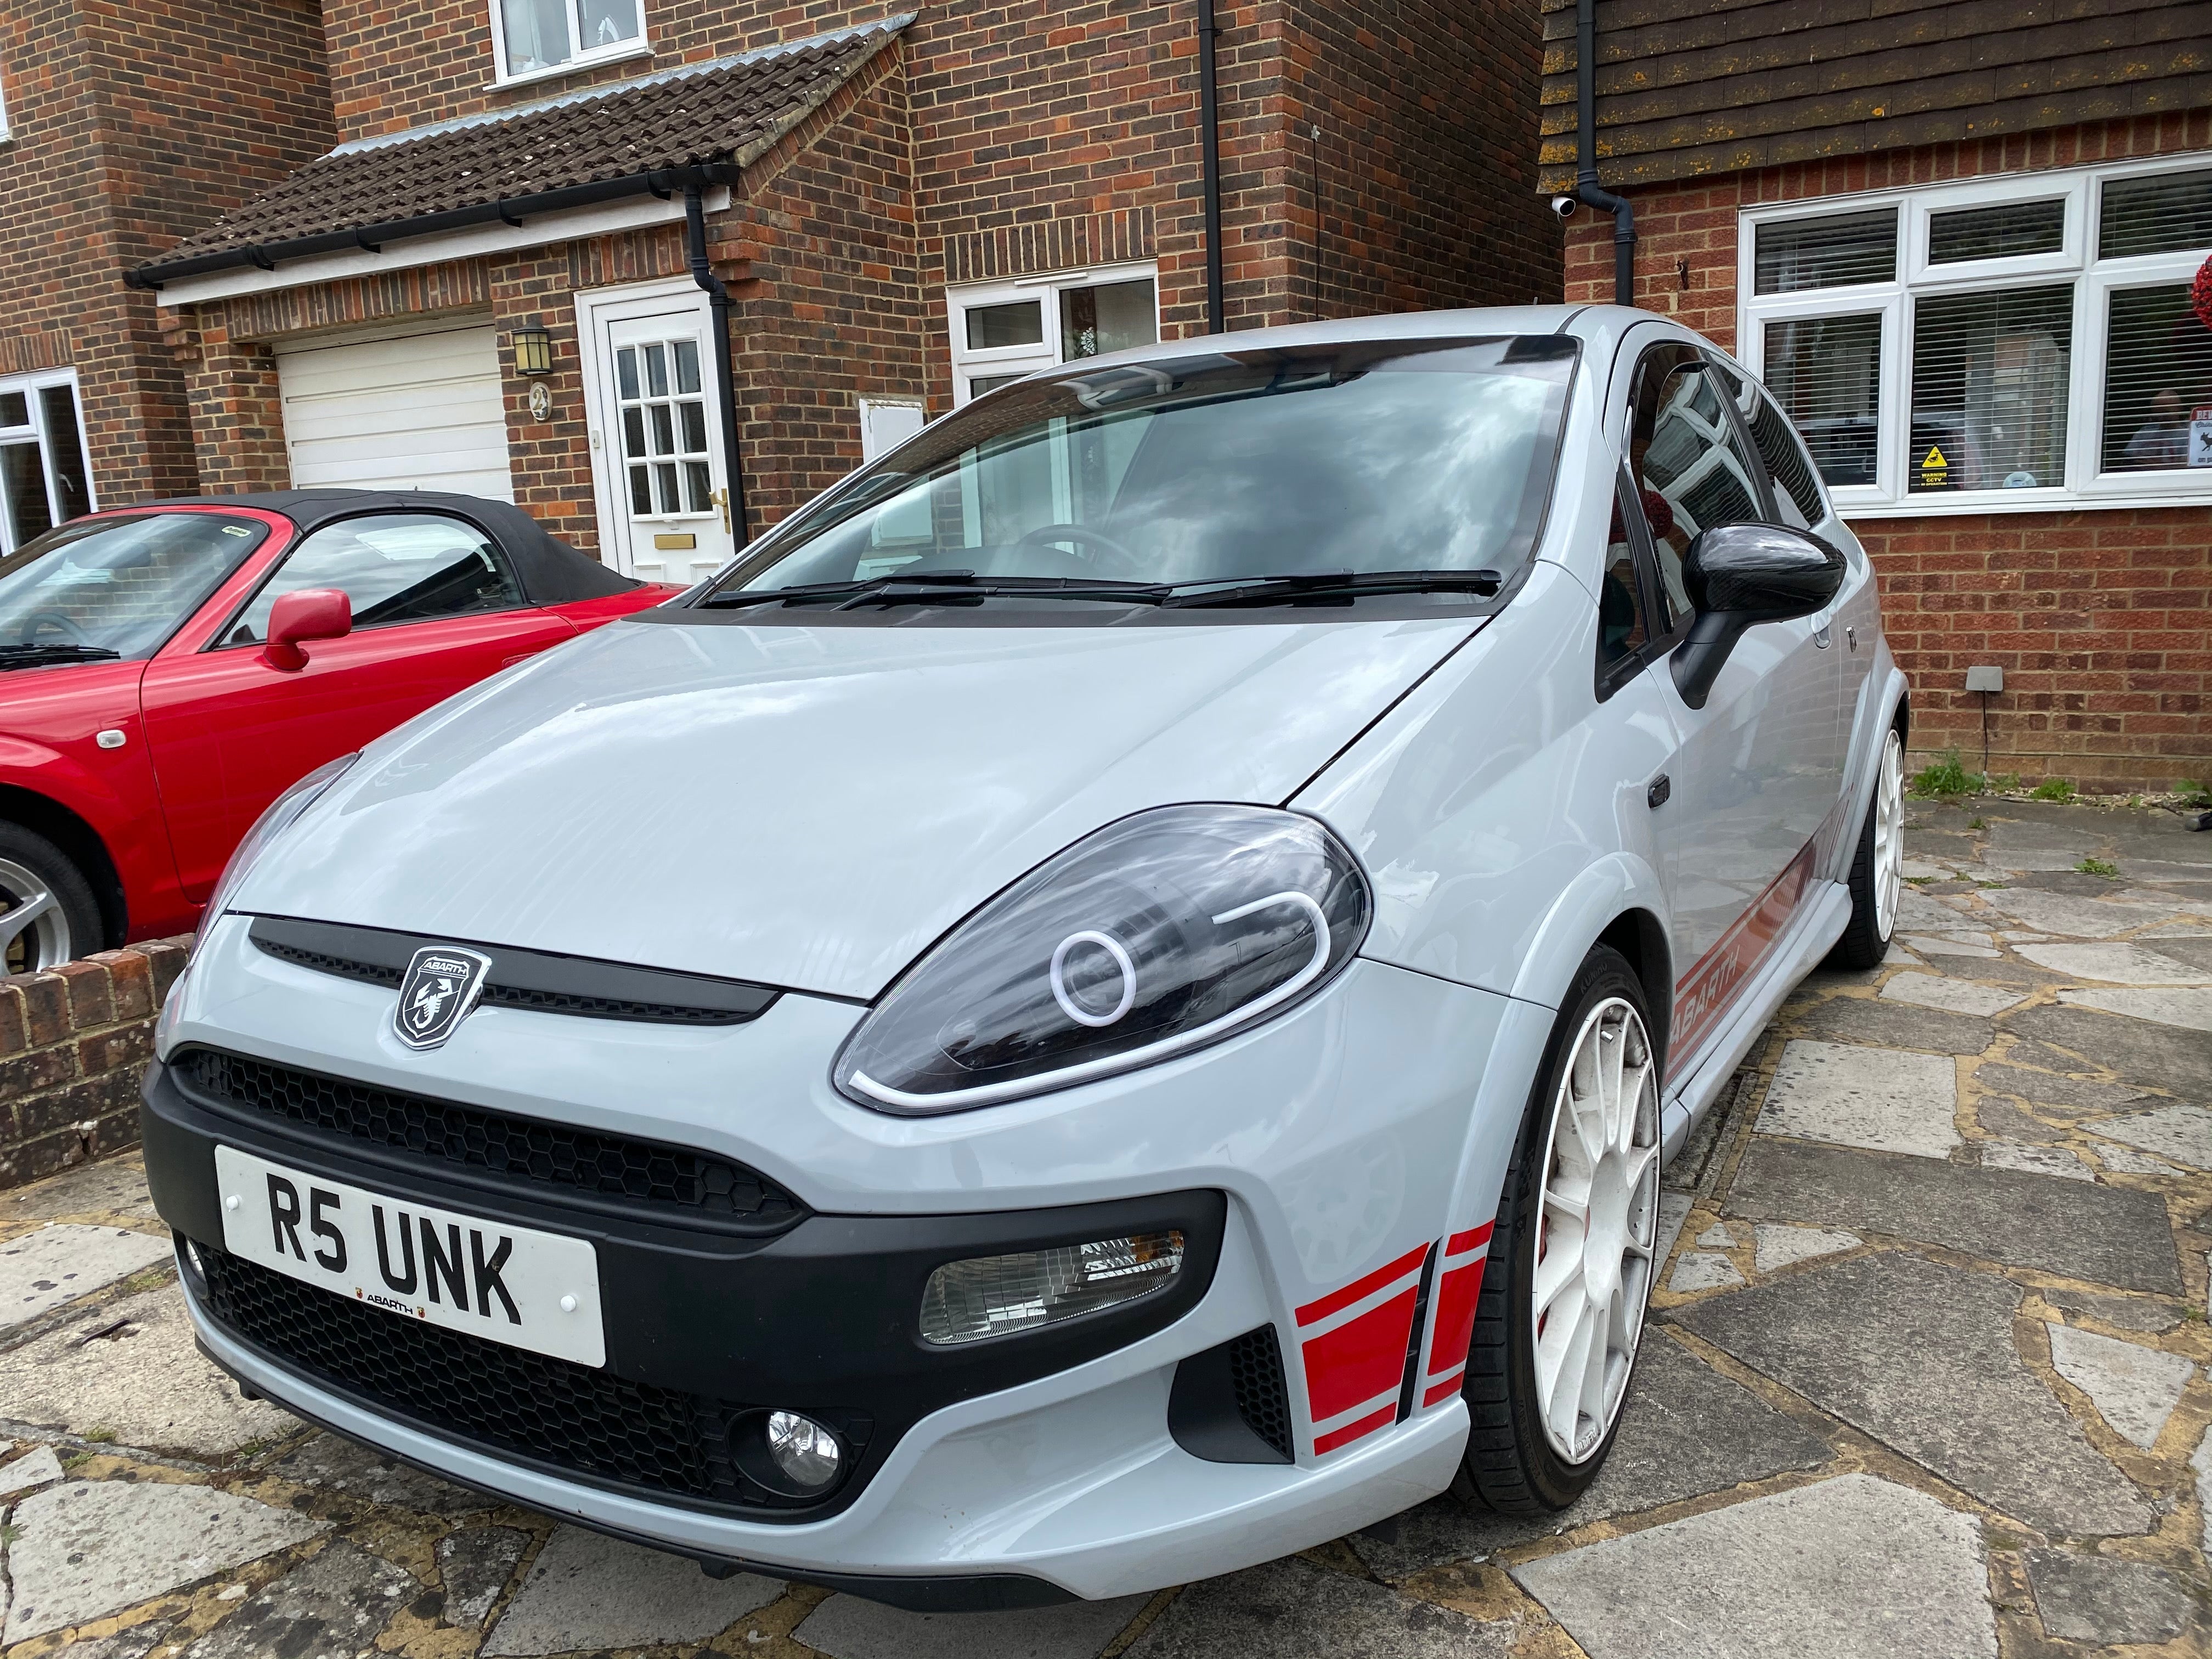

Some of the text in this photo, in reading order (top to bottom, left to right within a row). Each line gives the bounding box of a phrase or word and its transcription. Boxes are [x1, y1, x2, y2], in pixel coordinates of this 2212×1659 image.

[533, 389, 543, 410] 2
[424, 962, 466, 974] ABARTH
[1669, 944, 1740, 1045] ABARTH
[267, 1172, 522, 1325] R5 UNK
[367, 1294, 413, 1314] ABARTH
